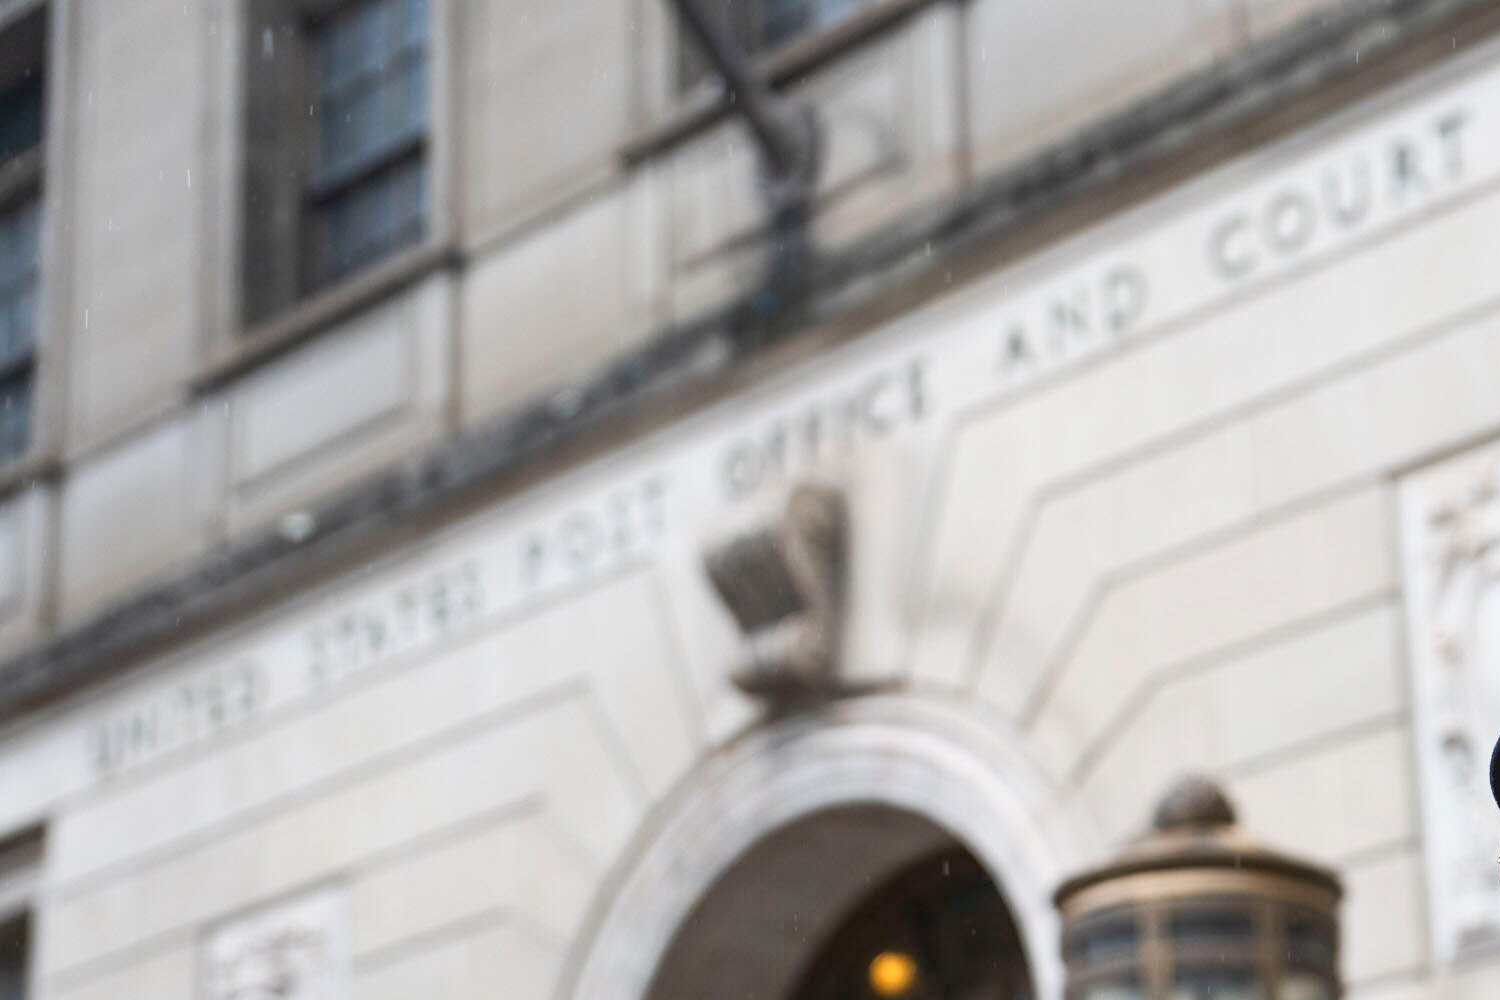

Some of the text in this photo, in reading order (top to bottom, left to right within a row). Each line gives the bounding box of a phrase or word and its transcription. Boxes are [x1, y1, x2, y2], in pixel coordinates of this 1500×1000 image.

[518, 474, 669, 588] POST
[721, 356, 930, 500] OFFICE
[1000, 267, 1147, 373] AND
[1205, 107, 1473, 281] COURT
